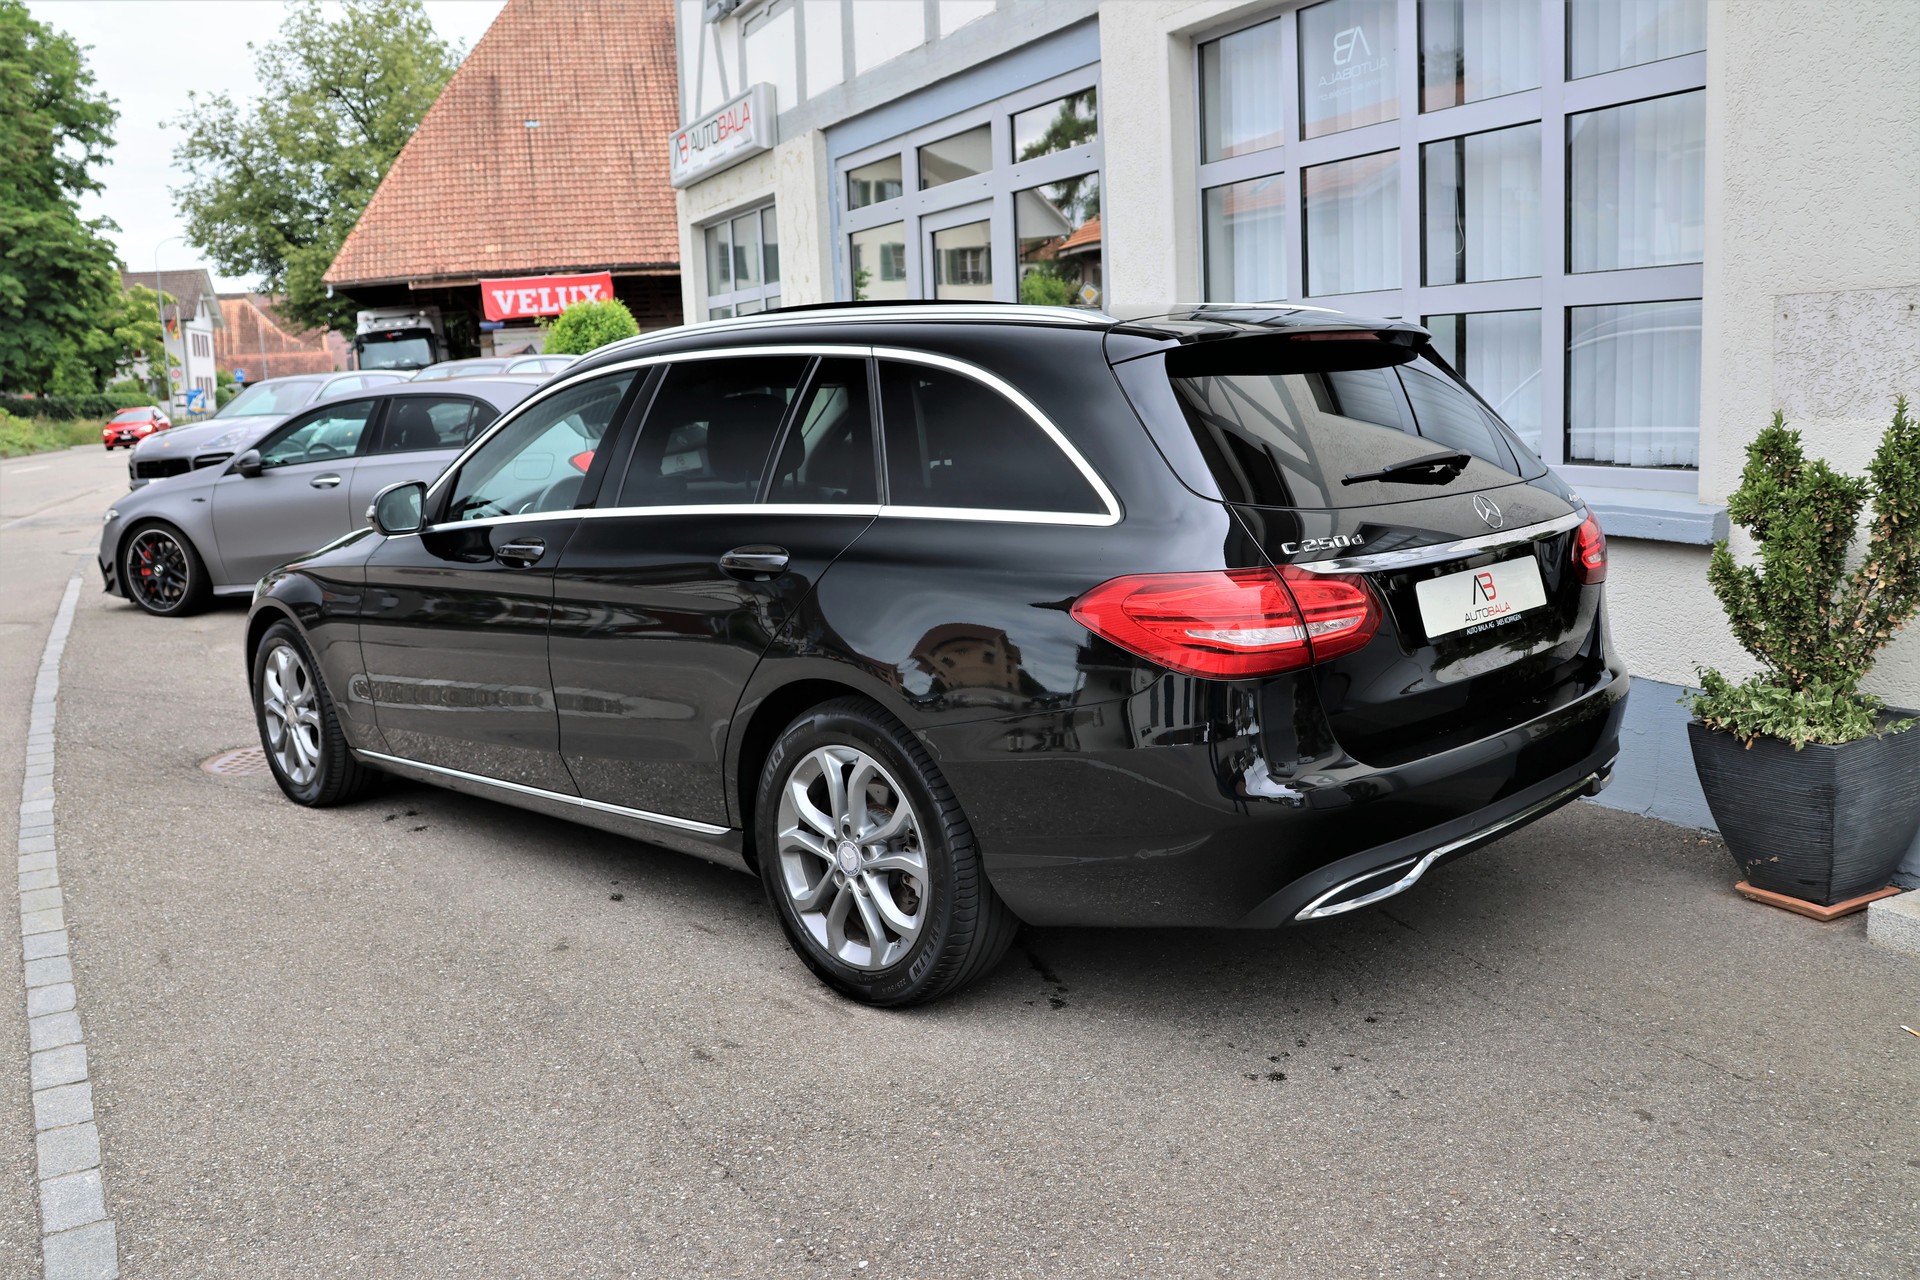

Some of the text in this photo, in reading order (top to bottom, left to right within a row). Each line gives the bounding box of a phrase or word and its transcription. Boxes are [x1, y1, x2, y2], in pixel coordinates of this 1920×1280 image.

[690, 102, 752, 156] AUTOBALA
[1465, 602, 1511, 624] AUTOBALA
[1466, 626, 1478, 635] AUTO
[1478, 623, 1489, 632] BALA
